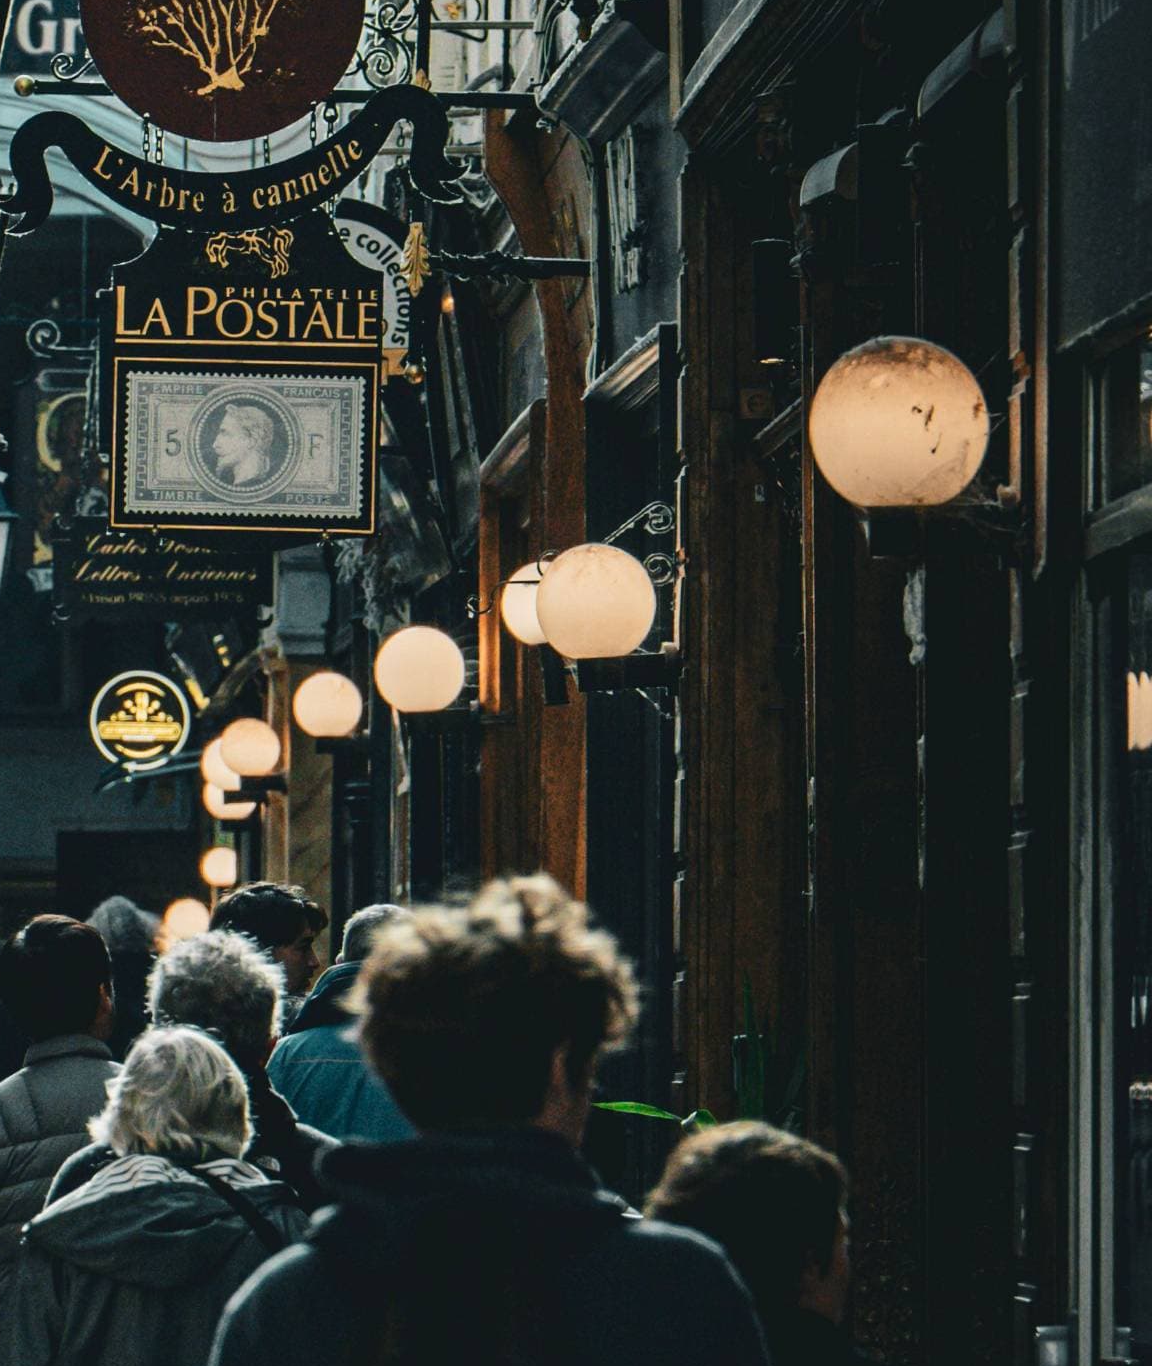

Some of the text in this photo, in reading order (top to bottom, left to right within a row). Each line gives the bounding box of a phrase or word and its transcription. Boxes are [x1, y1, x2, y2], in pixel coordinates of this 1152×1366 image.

[92, 138, 364, 214] L'Arbre à cannelle
[225, 287, 379, 301] PHILATELIE
[115, 285, 379, 340] LA POSTALE
[152, 384, 204, 395] EMPIRE
[164, 429, 325, 460] 5 F
[151, 490, 332, 505] TIMBRE POSTE
